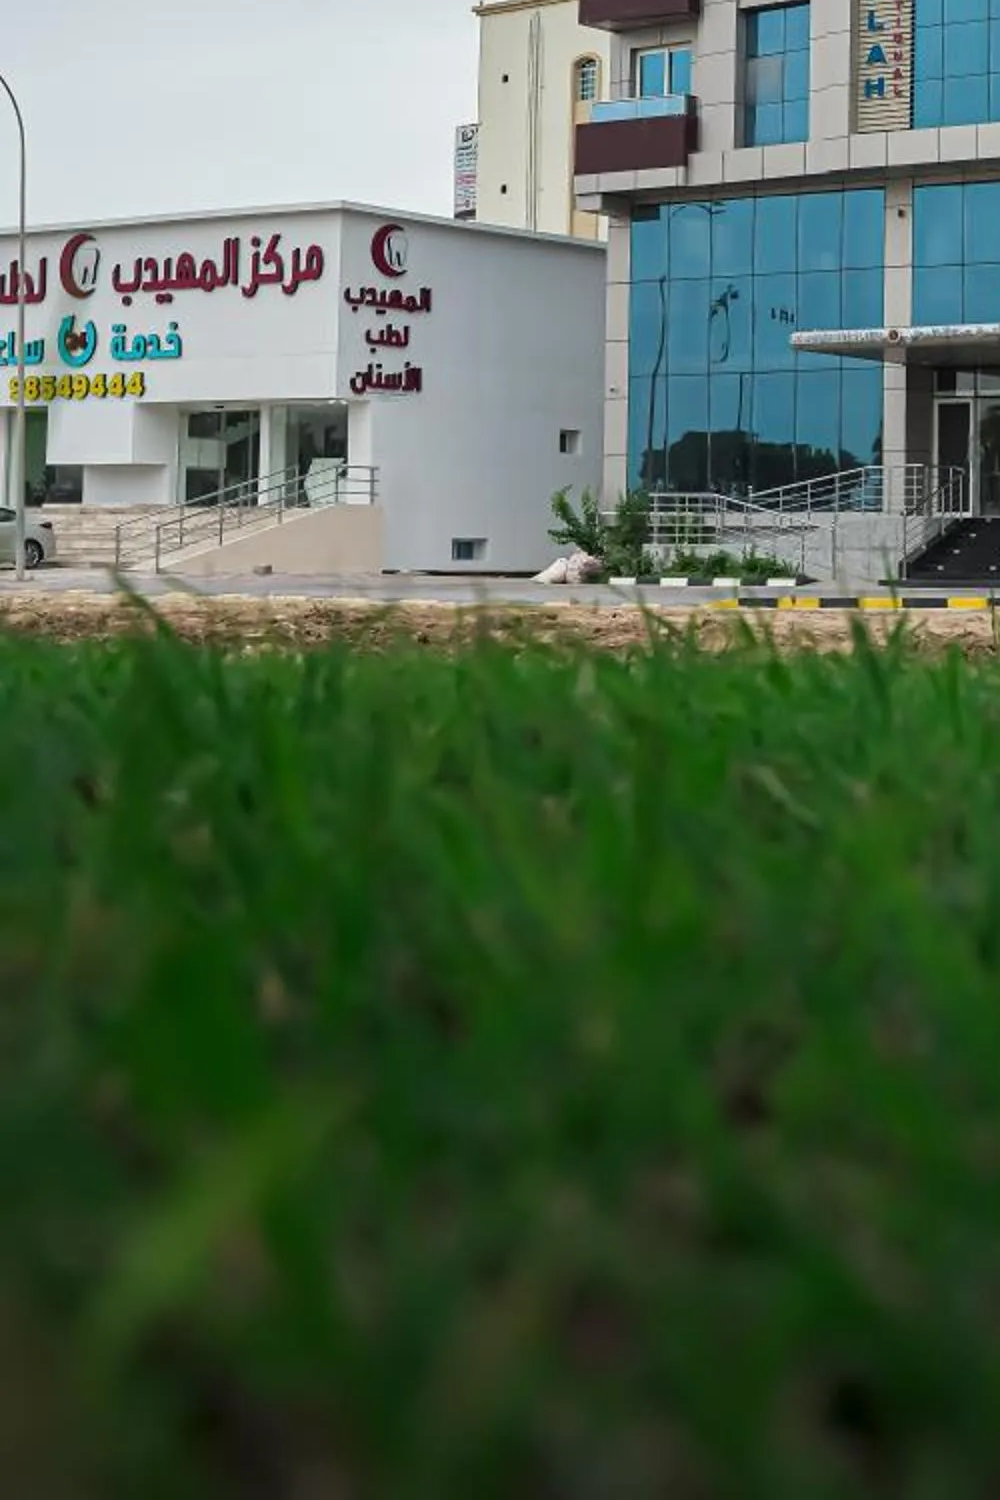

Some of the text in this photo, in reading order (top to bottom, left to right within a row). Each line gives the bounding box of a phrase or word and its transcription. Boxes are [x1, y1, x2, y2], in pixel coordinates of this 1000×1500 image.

[112, 237, 241, 307] المهيدب
[241, 234, 325, 299] مركز
[344, 286, 433, 315] المهيدب
[110, 322, 183, 362] خدمة
[365, 324, 411, 354] لطب
[350, 360, 423, 395] الأسنان
